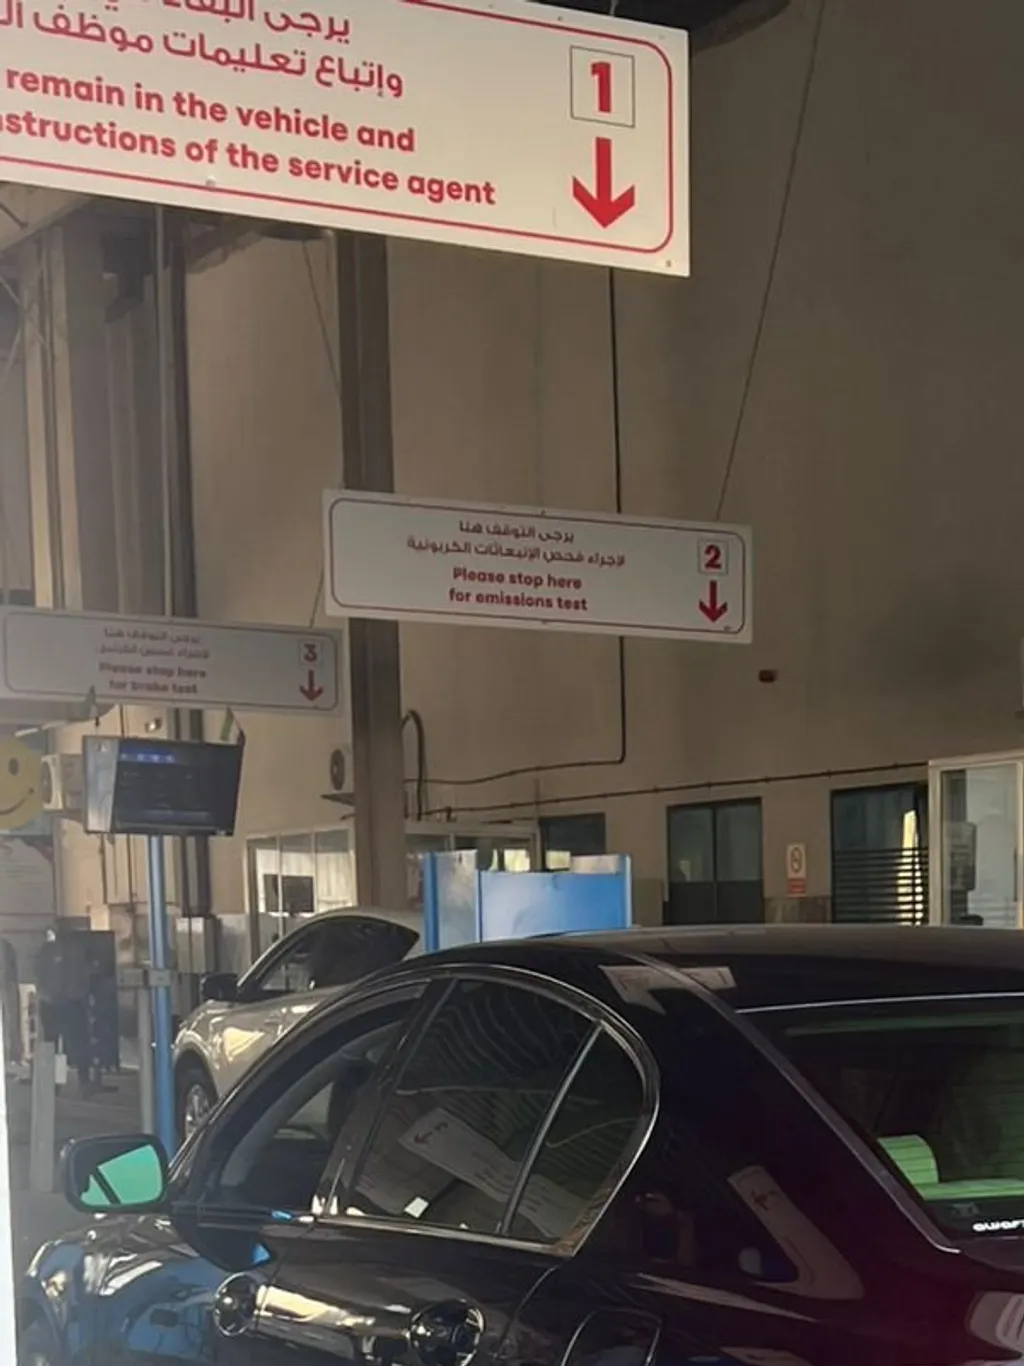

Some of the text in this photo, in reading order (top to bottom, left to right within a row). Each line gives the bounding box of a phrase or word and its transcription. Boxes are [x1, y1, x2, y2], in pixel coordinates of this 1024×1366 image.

[33, 5, 154, 53] موظف
[264, 11, 350, 45] يرجى
[163, 31, 307, 77] تعليمات
[315, 55, 403, 98] وإتباع
[591, 62, 613, 115] 1
[6, 68, 415, 153] remain in the vehicle and
[0, 110, 497, 206] structions of the service agent
[459, 520, 485, 535] هنا
[704, 543, 723, 571] 2
[452, 565, 583, 591] Please stop here
[448, 586, 589, 612] for emissions test
[303, 643, 318, 662] 3
